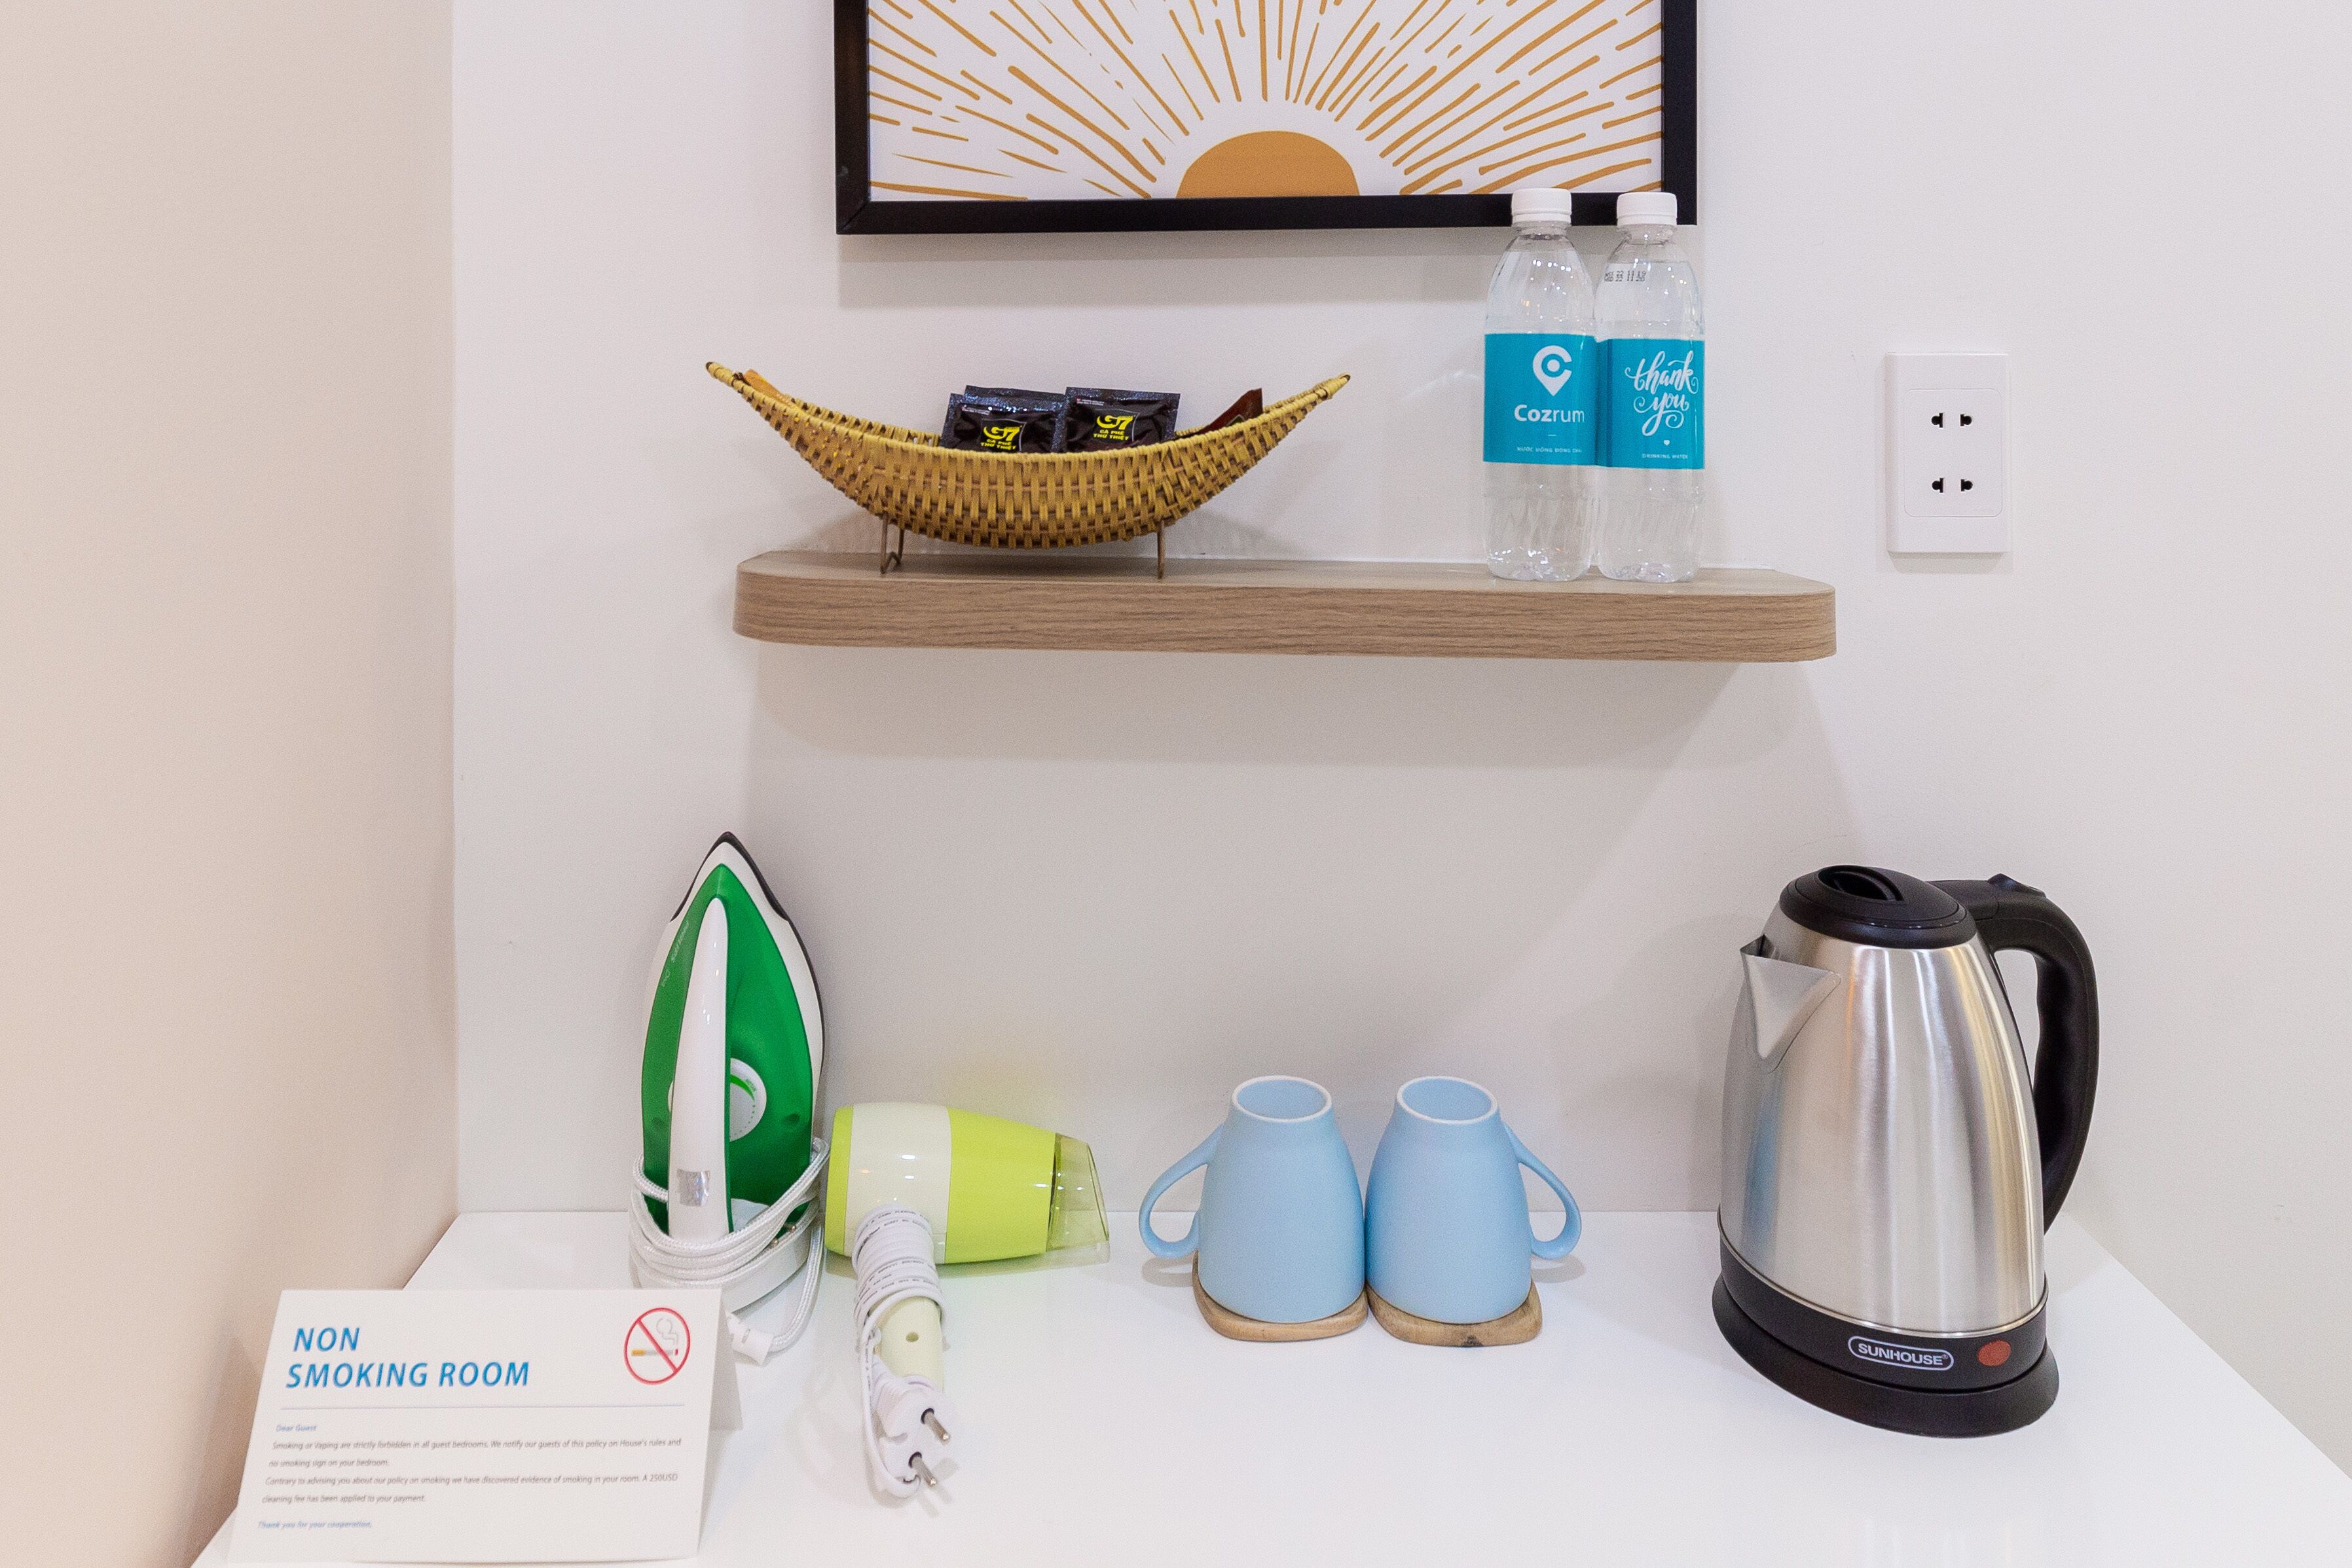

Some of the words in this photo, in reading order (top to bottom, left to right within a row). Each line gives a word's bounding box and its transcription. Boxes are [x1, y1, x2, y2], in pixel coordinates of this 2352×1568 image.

[1625, 350, 1699, 395] thank
[1514, 405, 1585, 424] Cozrum
[1633, 393, 1689, 437] you
[293, 1326, 361, 1353] NON
[1858, 1342, 1943, 1366] SUNHOUSE
[285, 1361, 428, 1389] SMOKING
[438, 1361, 530, 1387] ROOM
[272, 1442, 303, 1450] Smoking
[314, 1442, 338, 1450] Vaping
[353, 1440, 375, 1449] strictly
[377, 1440, 411, 1449] forbidden
[431, 1441, 450, 1450] guest
[503, 1440, 523, 1449] notify
[538, 1441, 560, 1449] guests
[562, 1440, 570, 1448] of
[585, 1439, 606, 1449] policy
[281, 1459, 310, 1468] smoking
[312, 1459, 326, 1468] sign
[265, 1477, 295, 1486] Contrary
[307, 1476, 335, 1486] advising
[387, 1476, 407, 1485] policy
[421, 1476, 450, 1485] smoking
[553, 1475, 561, 1484] of
[562, 1475, 592, 1484] smoking
[262, 1495, 291, 1504] cleaning
[339, 1494, 365, 1503] applied
